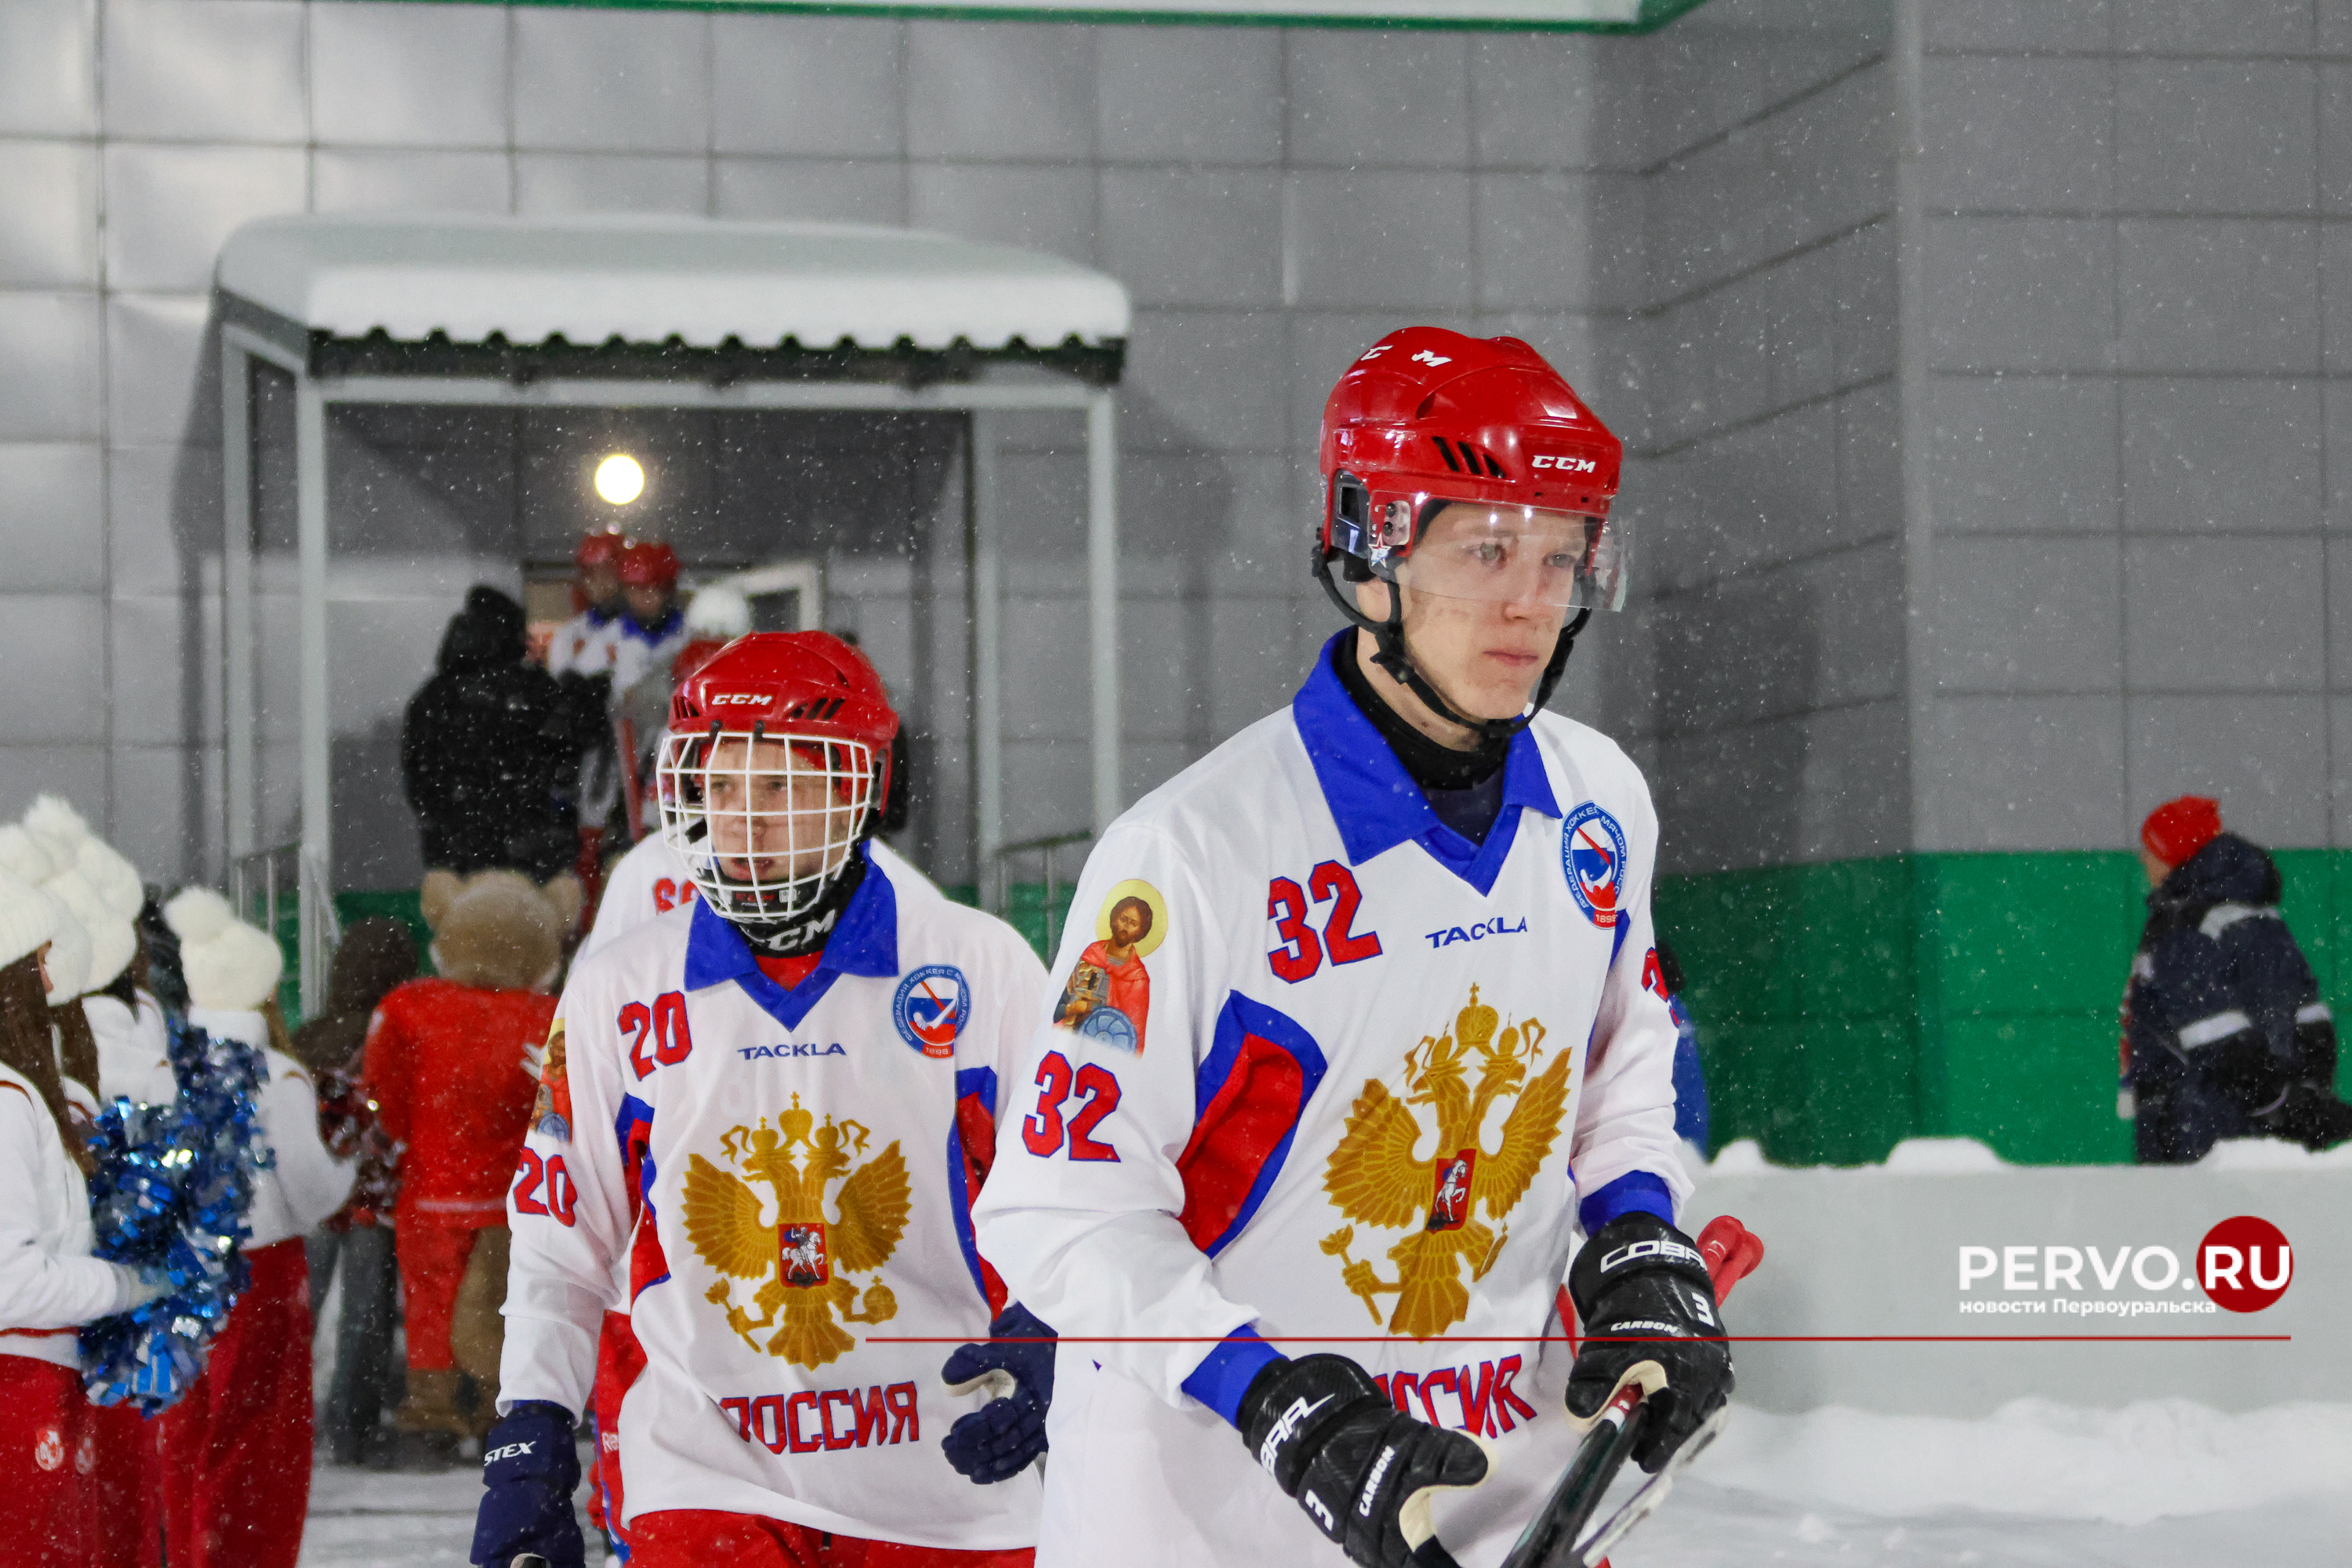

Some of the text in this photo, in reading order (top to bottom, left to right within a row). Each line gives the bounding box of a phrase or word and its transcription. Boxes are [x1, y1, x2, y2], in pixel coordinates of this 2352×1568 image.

[1531, 455, 1596, 474] CCM
[711, 694, 773, 706] CCM
[1565, 805, 1599, 833] ХОККЕ
[1563, 832, 1590, 909] ФЕДЕРАЦИЯ
[739, 909, 836, 951] CM
[1267, 859, 1383, 985] 32
[1425, 916, 1528, 949] TACKLA
[895, 983, 913, 1041] ФЕДЕРАЦИЯ
[909, 968, 945, 984] ХОККЕЯ
[617, 990, 692, 1082] 20
[737, 1043, 847, 1061] TACKLA
[1022, 1050, 1122, 1163] 32
[513, 1145, 579, 1228] 20
[1610, 1320, 1679, 1334] CARBON
[1691, 1291, 1715, 1327] 3
[1359, 1445, 1396, 1518] CARBON
[1305, 1489, 1334, 1531] 3
